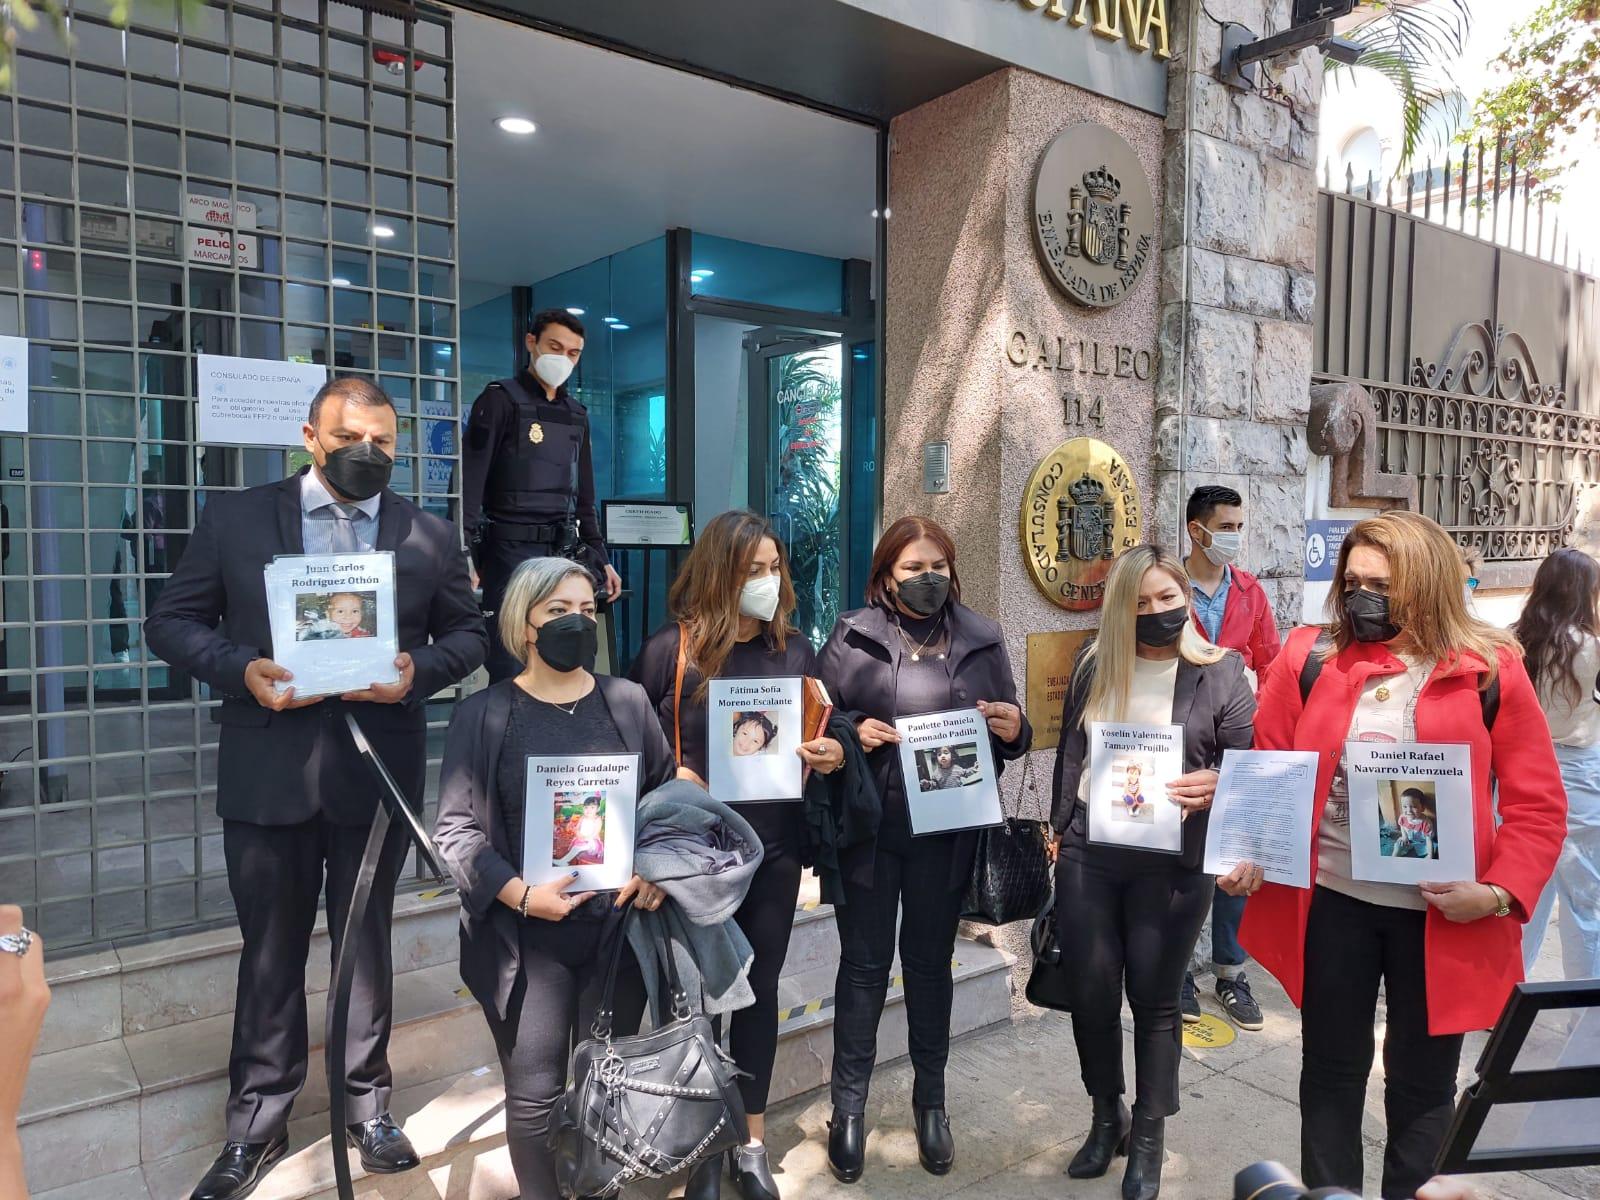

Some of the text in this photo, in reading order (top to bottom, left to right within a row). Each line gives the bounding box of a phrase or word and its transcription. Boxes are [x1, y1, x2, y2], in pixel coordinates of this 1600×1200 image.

[190, 197, 209, 207] ARCO
[197, 237, 246, 251] PELIGO
[1100, 284, 1120, 302] DE
[1007, 331, 1151, 381] GALILEO
[210, 371, 258, 382] CONSULADO
[1061, 391, 1106, 428] 114
[1031, 462, 1064, 582] CONSULADO
[306, 563, 365, 575] Juan Carlos
[347, 575, 379, 585] Othón
[730, 685, 781, 695] Fátima Sofía
[718, 697, 793, 708] Moreno Escalante
[907, 716, 974, 732] Paulette Daniela
[908, 727, 978, 744] Coronado Padilla
[1132, 730, 1172, 740] Valentina
[1103, 741, 1170, 754] Tamayo Trujillo
[1370, 750, 1445, 761] Daniel Rafael
[536, 763, 630, 774] Daniela Guadalupe
[1354, 764, 1464, 777] Navarro Valenzuela
[545, 777, 620, 789] Reyes Carretas
